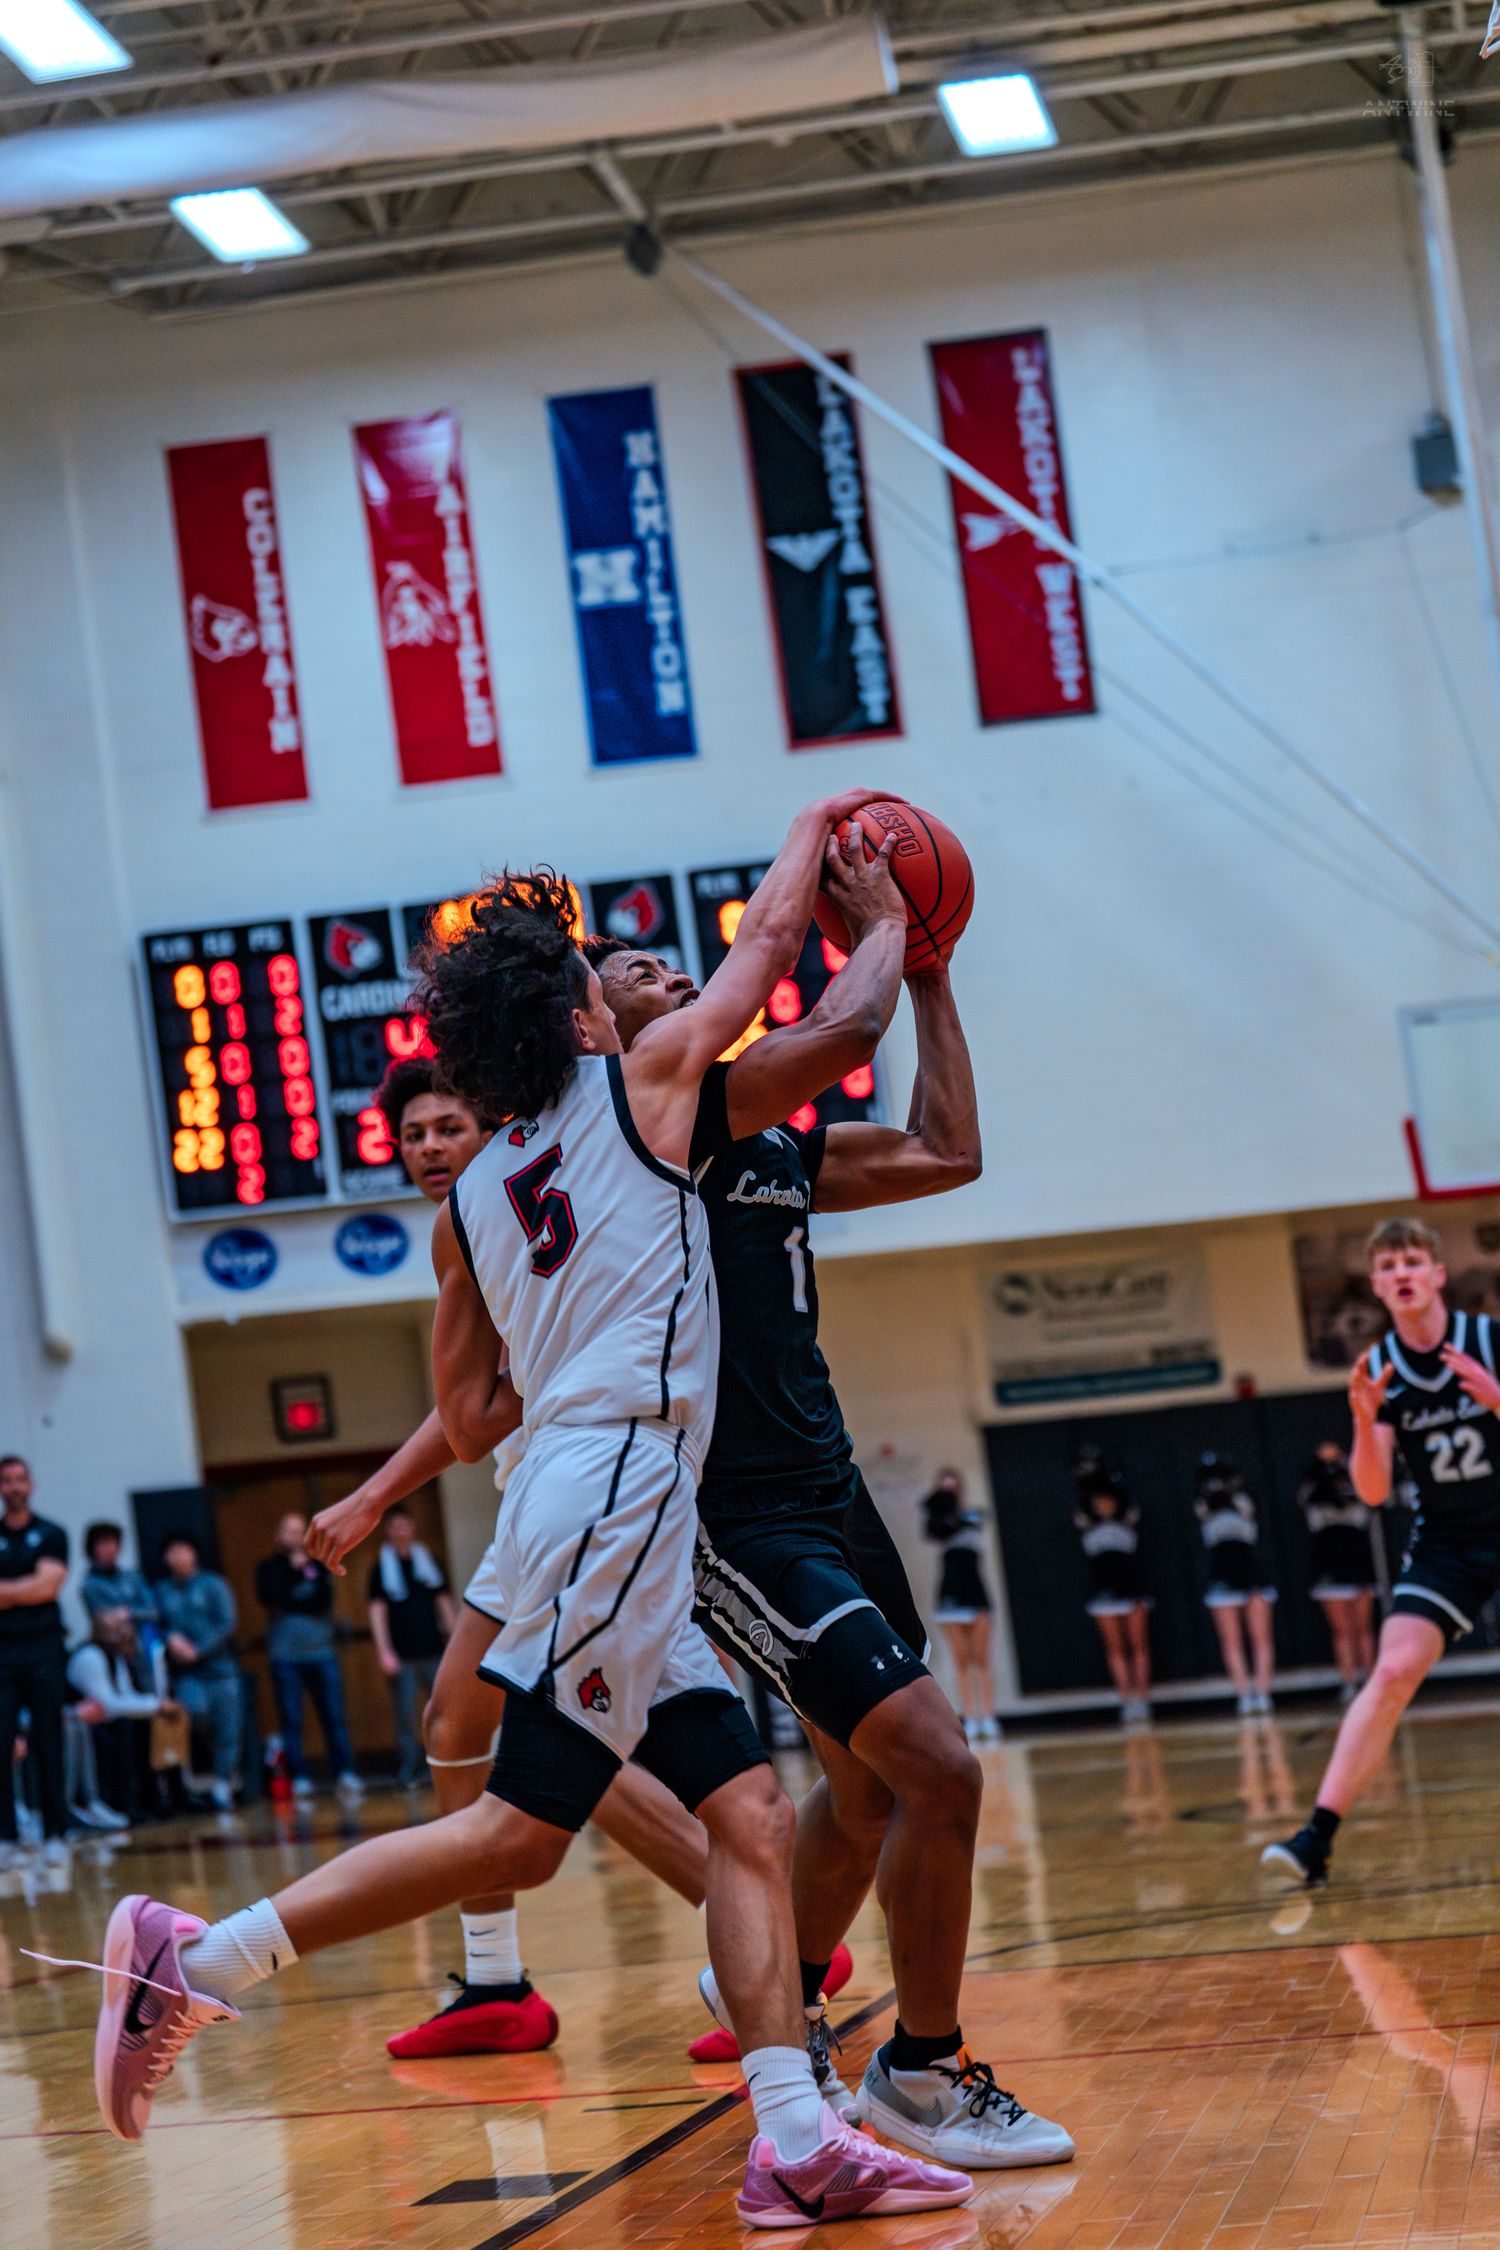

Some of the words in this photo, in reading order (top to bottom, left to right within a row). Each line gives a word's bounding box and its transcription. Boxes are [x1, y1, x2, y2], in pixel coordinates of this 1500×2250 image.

[242, 487, 299, 754] COLERAIN
[432, 458, 496, 747] AIRFIELD
[624, 430, 687, 716] HAMILTON
[1035, 562, 1084, 701] WEST
[844, 585, 891, 724] EAST
[503, 1142, 579, 1280] 5
[783, 1225, 809, 1313] 1
[1424, 1425, 1493, 1484] 22
